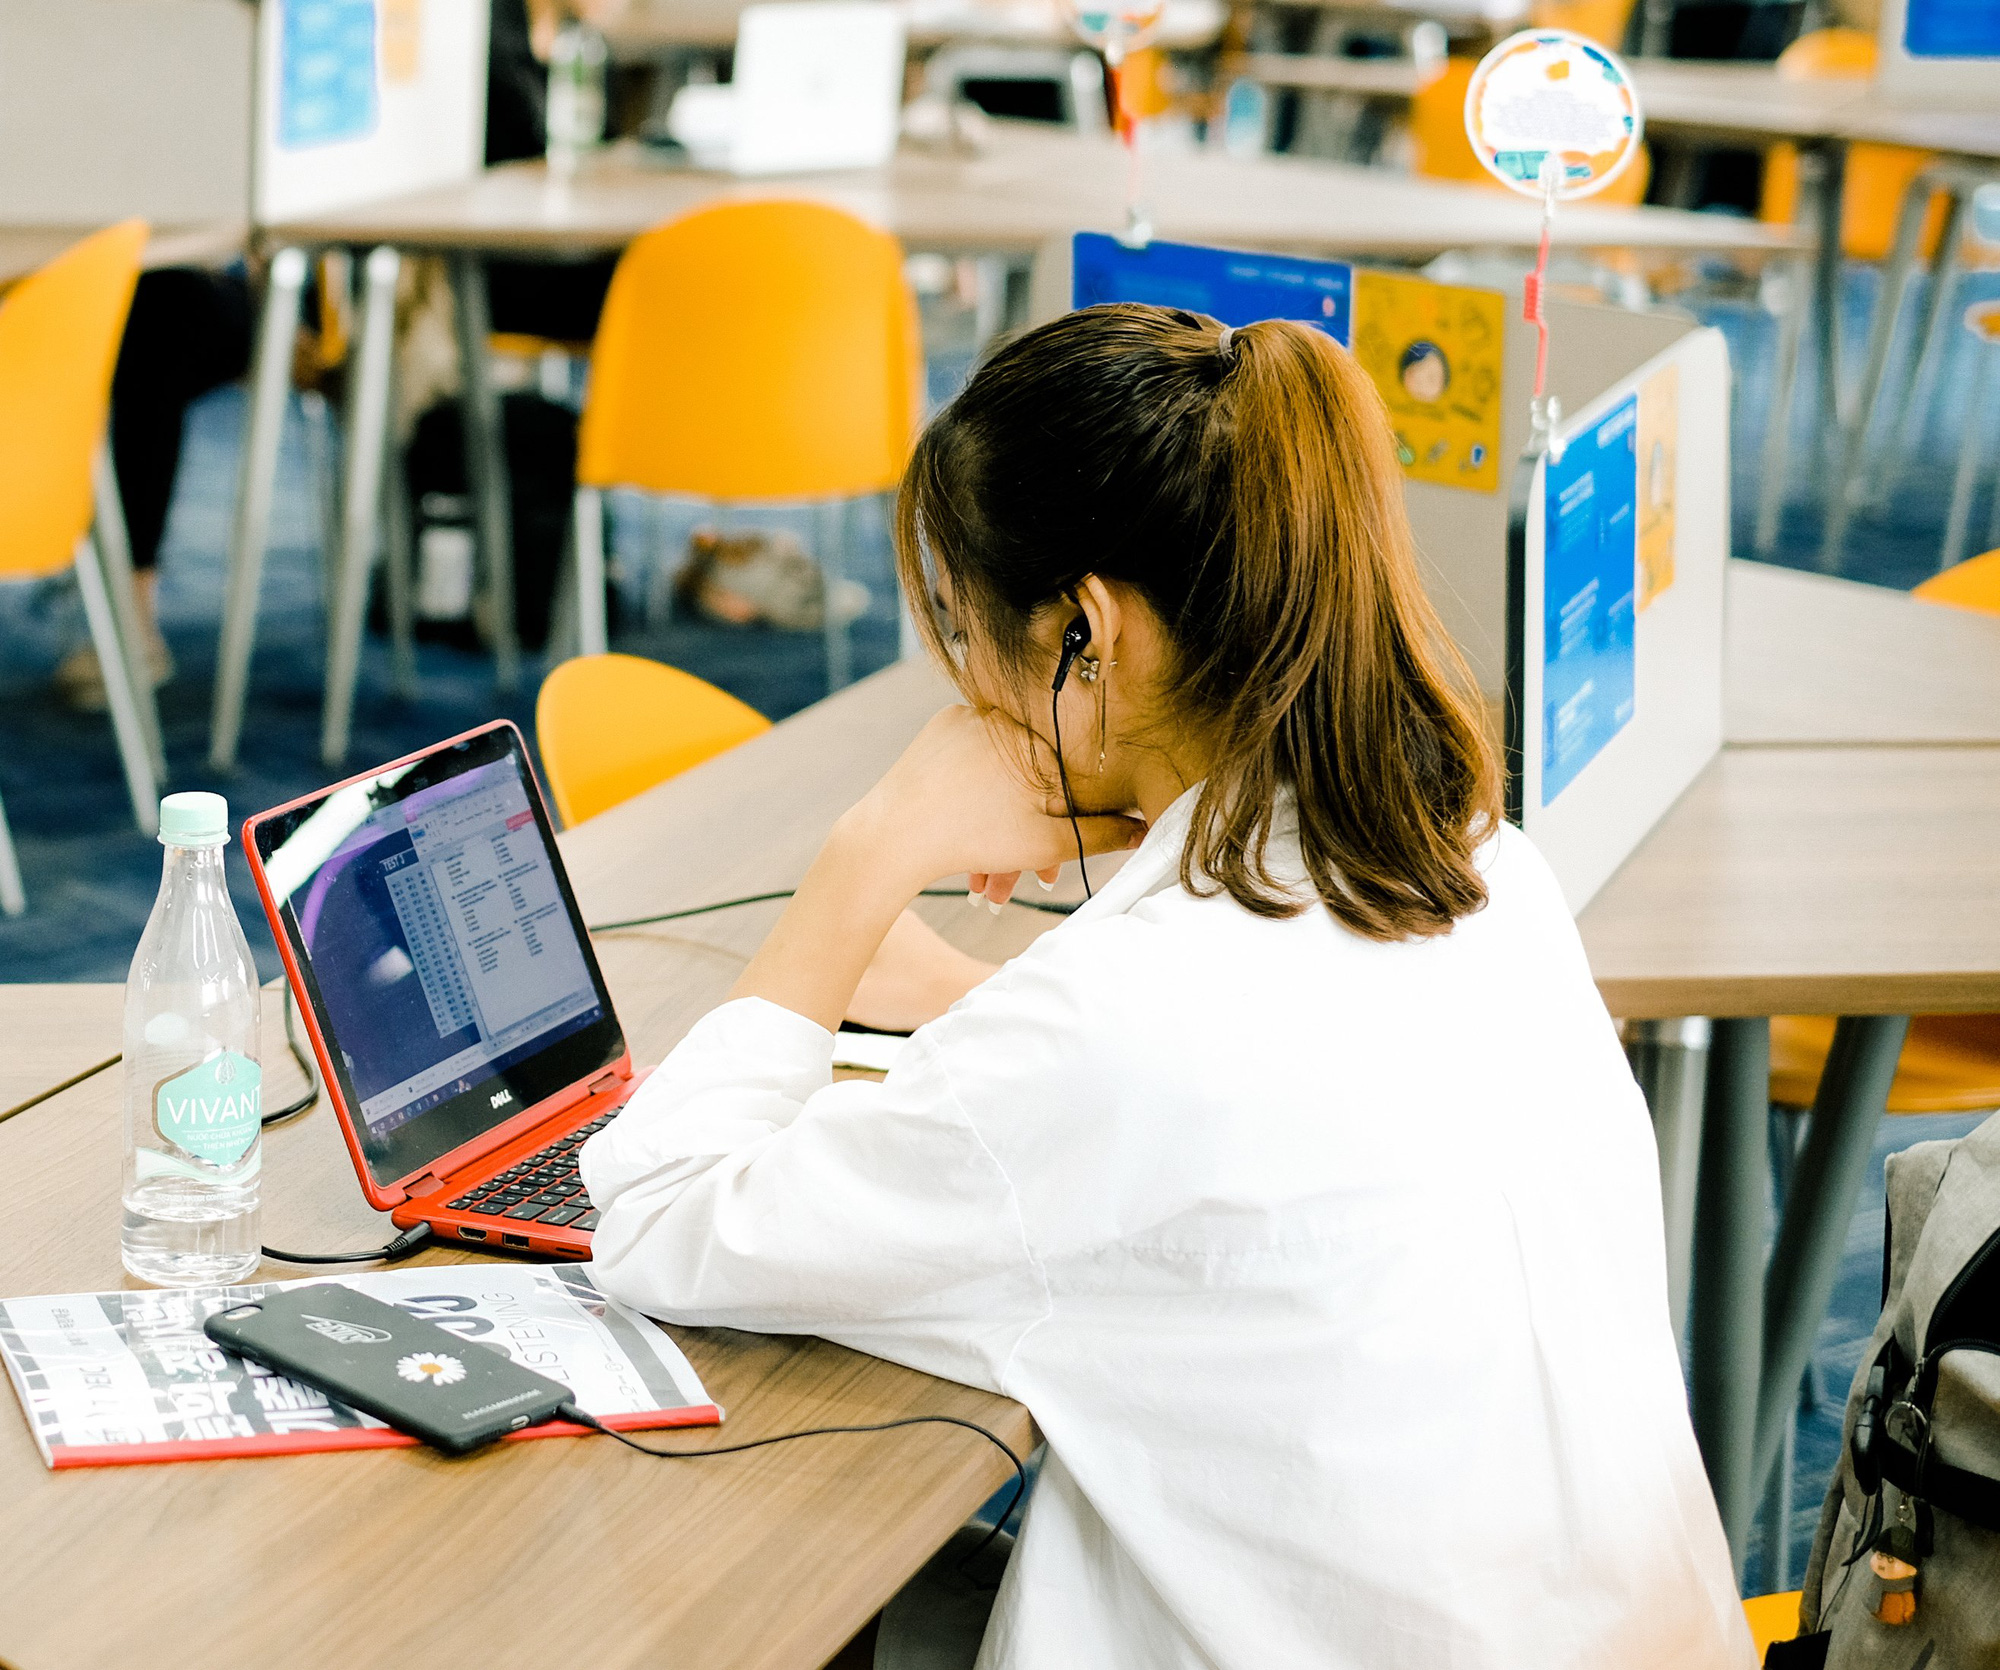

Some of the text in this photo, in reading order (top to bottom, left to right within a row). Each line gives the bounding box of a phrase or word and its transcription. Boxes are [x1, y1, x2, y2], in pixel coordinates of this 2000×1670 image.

[167, 1084, 261, 1125] VIVANT
[490, 1089, 513, 1109] DELL
[482, 1291, 570, 1381] LISTENING
